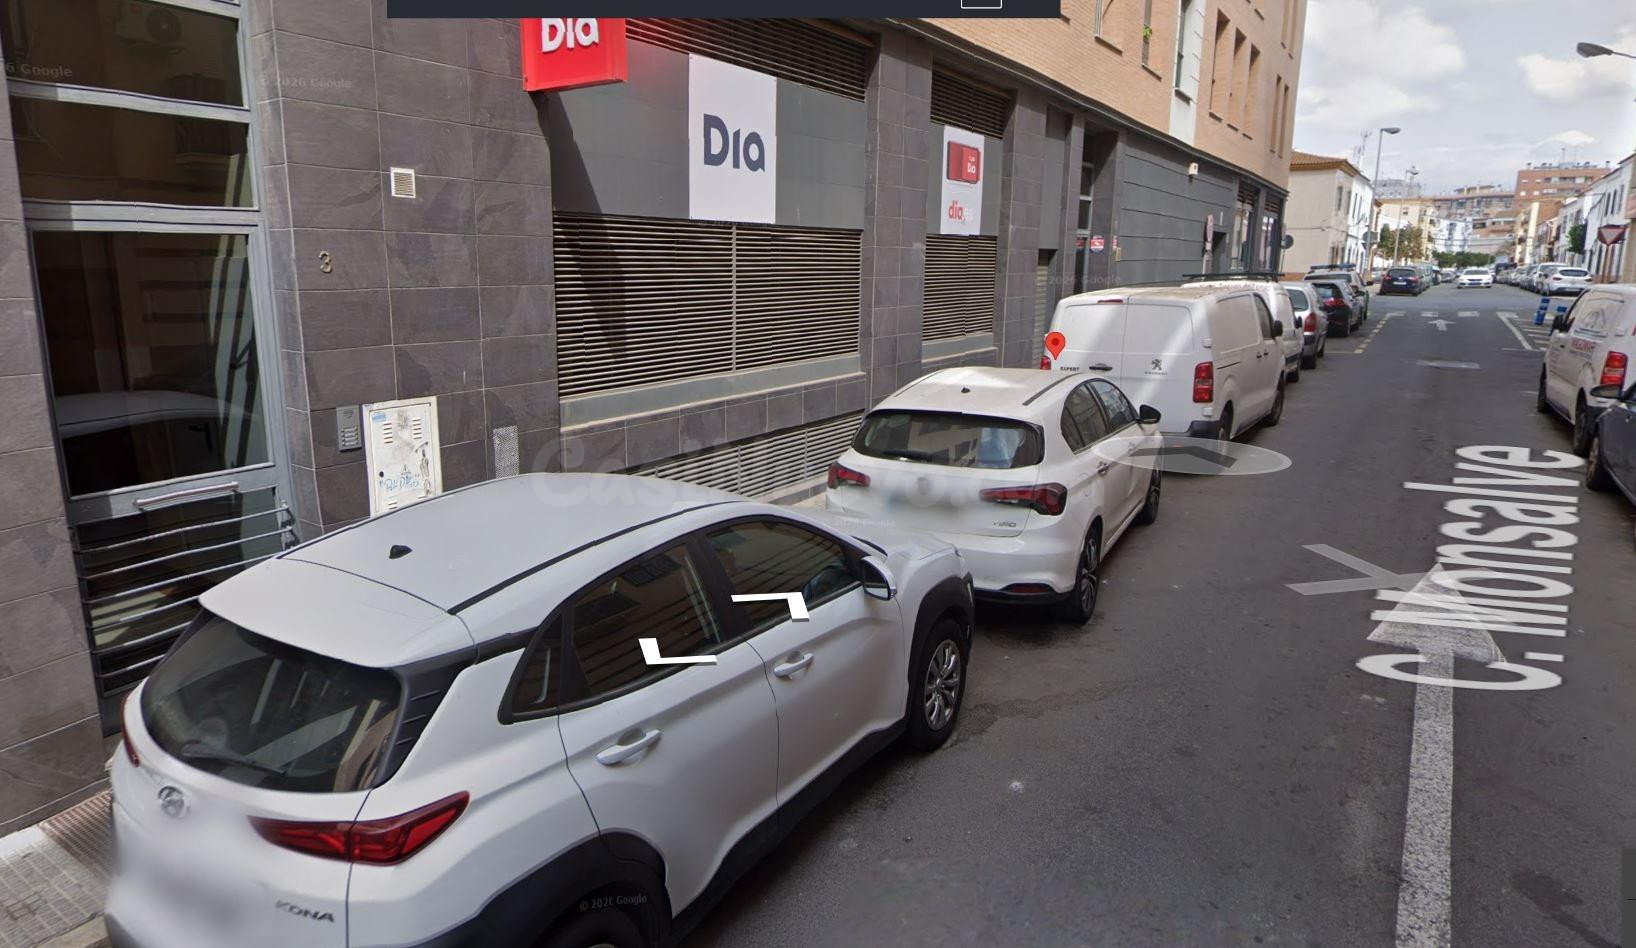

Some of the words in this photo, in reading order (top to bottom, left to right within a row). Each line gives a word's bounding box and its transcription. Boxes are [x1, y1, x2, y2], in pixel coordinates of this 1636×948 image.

[703, 113, 766, 172] Dia
[319, 250, 332, 274] 3
[275, 900, 335, 922] KONA
